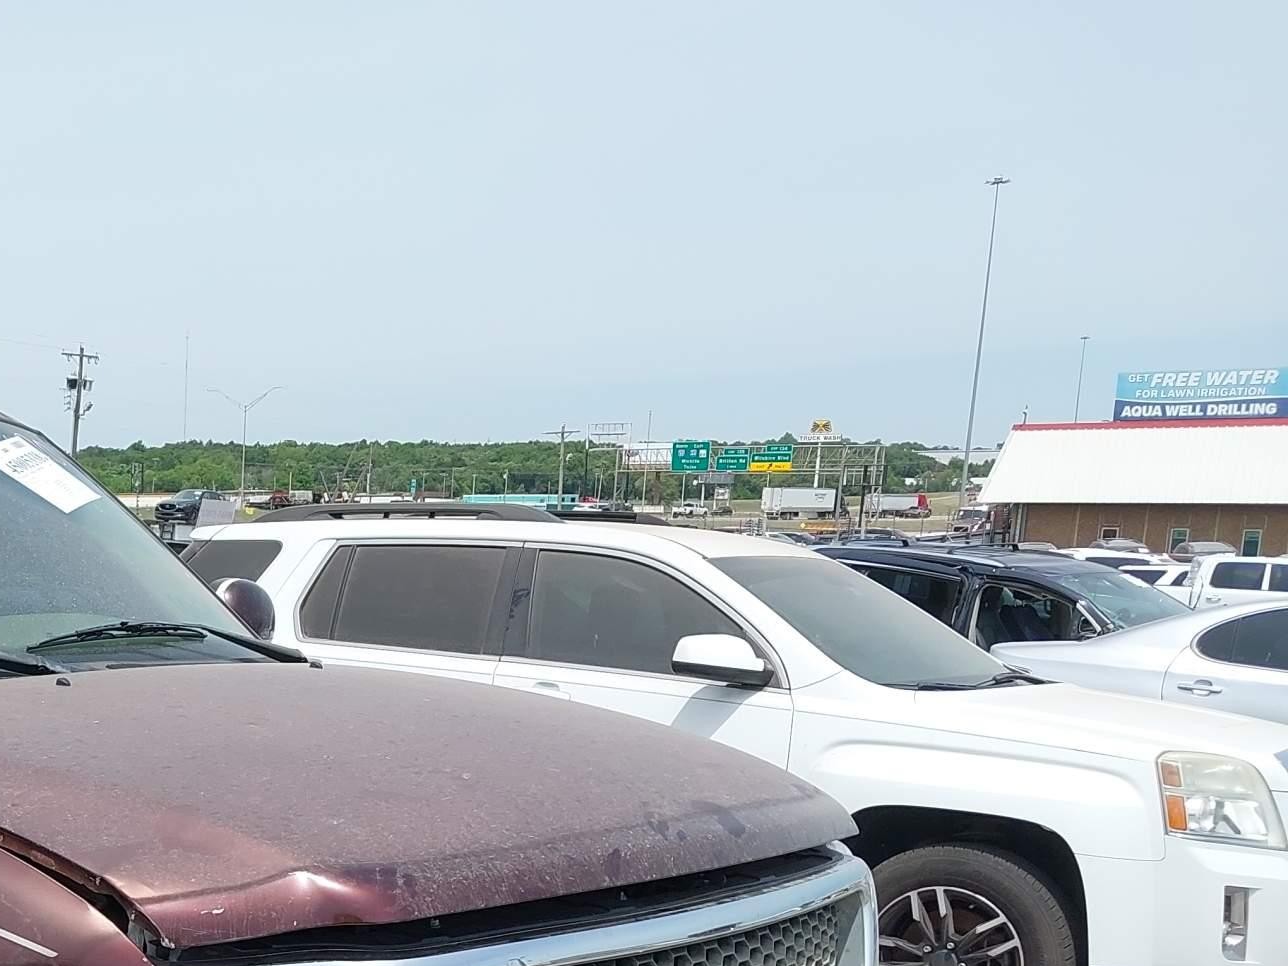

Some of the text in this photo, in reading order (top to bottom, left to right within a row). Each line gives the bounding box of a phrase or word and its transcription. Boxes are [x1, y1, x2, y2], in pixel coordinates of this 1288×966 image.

[1128, 370, 1280, 387] GET FREE WATER
[1135, 387, 1266, 398] FOR LAWN IRRIGATION
[1120, 403, 1278, 417] AQUA WELL DRILLING
